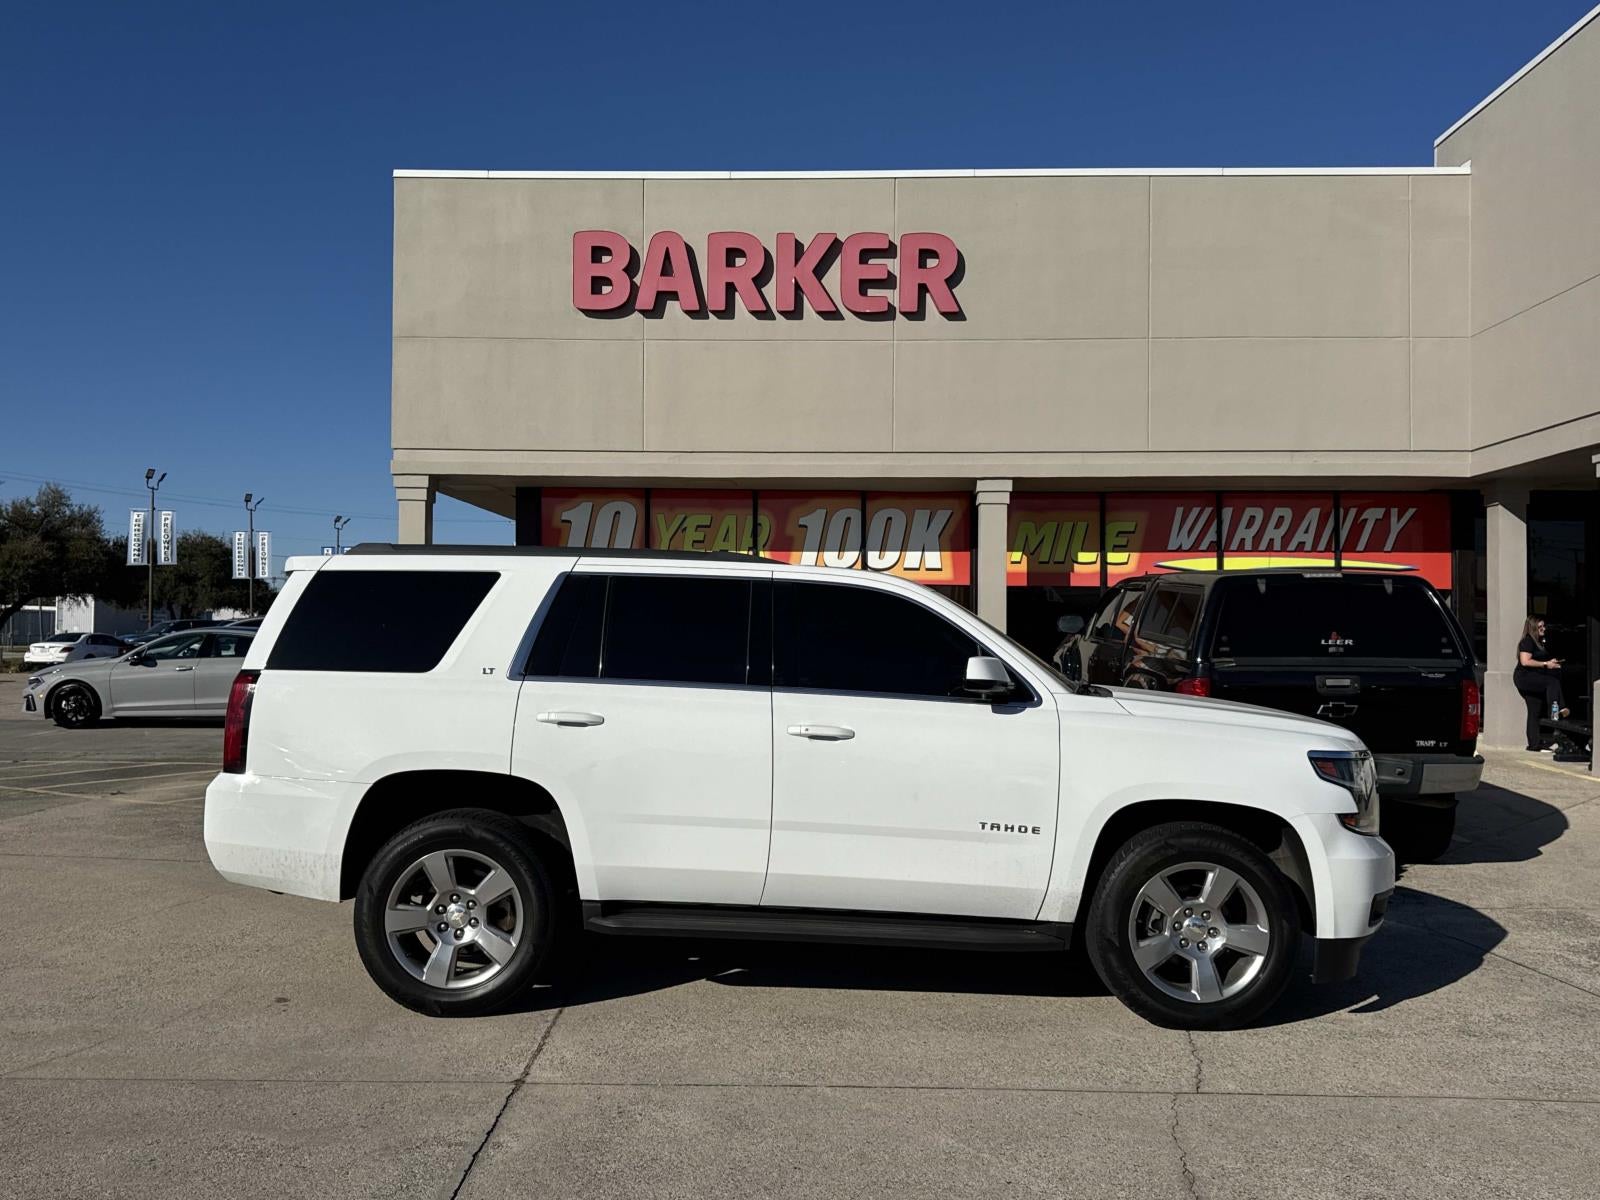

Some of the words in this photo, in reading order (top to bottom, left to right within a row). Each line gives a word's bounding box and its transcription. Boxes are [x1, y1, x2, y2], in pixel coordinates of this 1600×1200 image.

[573, 231, 963, 316] BARKER
[561, 501, 637, 549] 10
[656, 513, 771, 557] YEAR
[799, 508, 953, 571] 100K
[1011, 521, 1137, 565] MILE
[1167, 506, 1418, 552] WARRANTY
[482, 667, 496, 675] LT
[979, 821, 1041, 835] TAHOE
